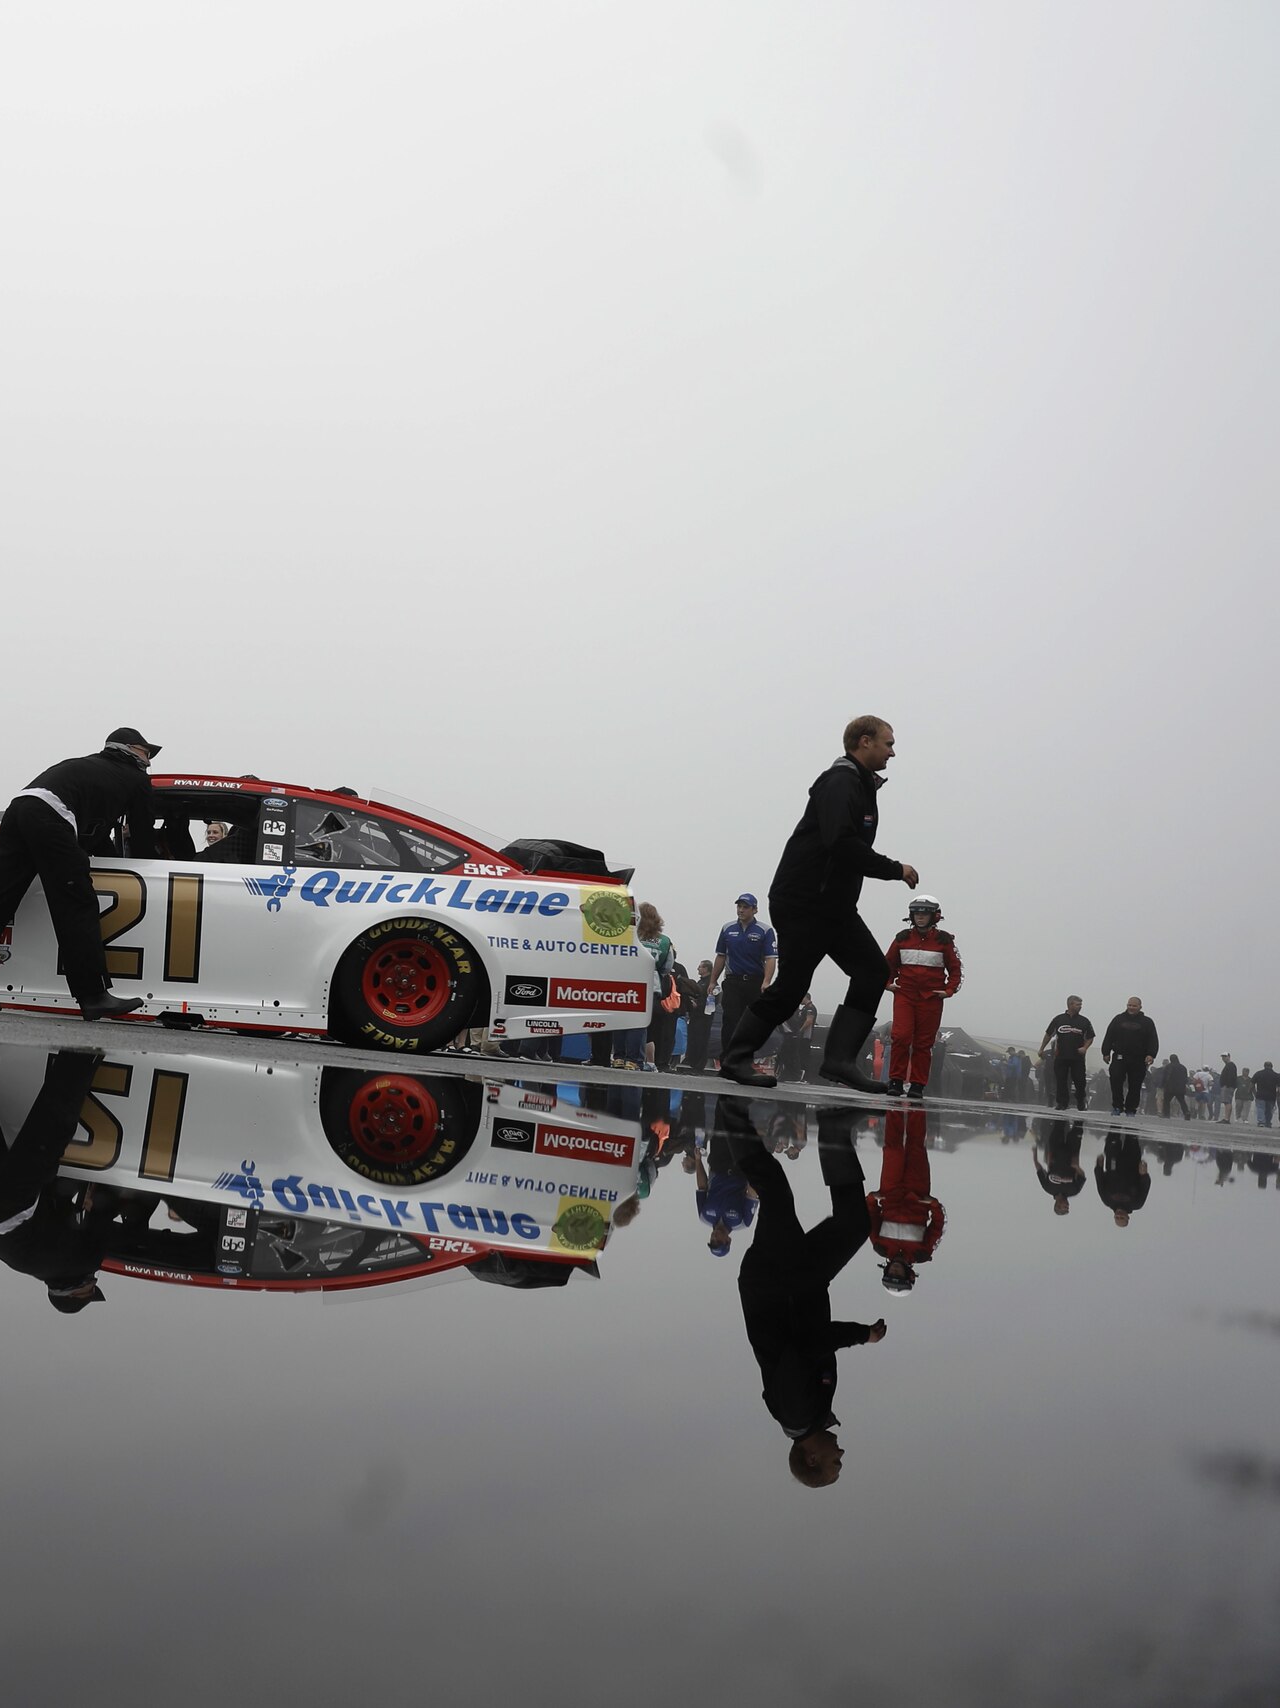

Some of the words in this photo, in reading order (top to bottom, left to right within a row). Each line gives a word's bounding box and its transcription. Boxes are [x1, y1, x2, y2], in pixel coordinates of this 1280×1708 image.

[174, 779, 200, 787] RYAN
[202, 780, 243, 789] BLANEY
[264, 821, 284, 832] PPG
[463, 863, 510, 877] SKF
[300, 870, 446, 907] Quick
[454, 879, 570, 917] Lane
[588, 891, 628, 908] AMERICAN
[57, 868, 204, 983] 21
[590, 922, 627, 936] ETHANOL
[369, 919, 471, 974] GOODYEAR
[488, 936, 519, 950] TIRE
[523, 939, 531, 950] &
[535, 940, 577, 953] AUTO
[580, 942, 639, 957] CENTER
[514, 985, 537, 996] Ford
[556, 986, 639, 1005] Motorcraft
[527, 1020, 557, 1028] LINCOLN
[361, 1022, 419, 1050] EAGLE
